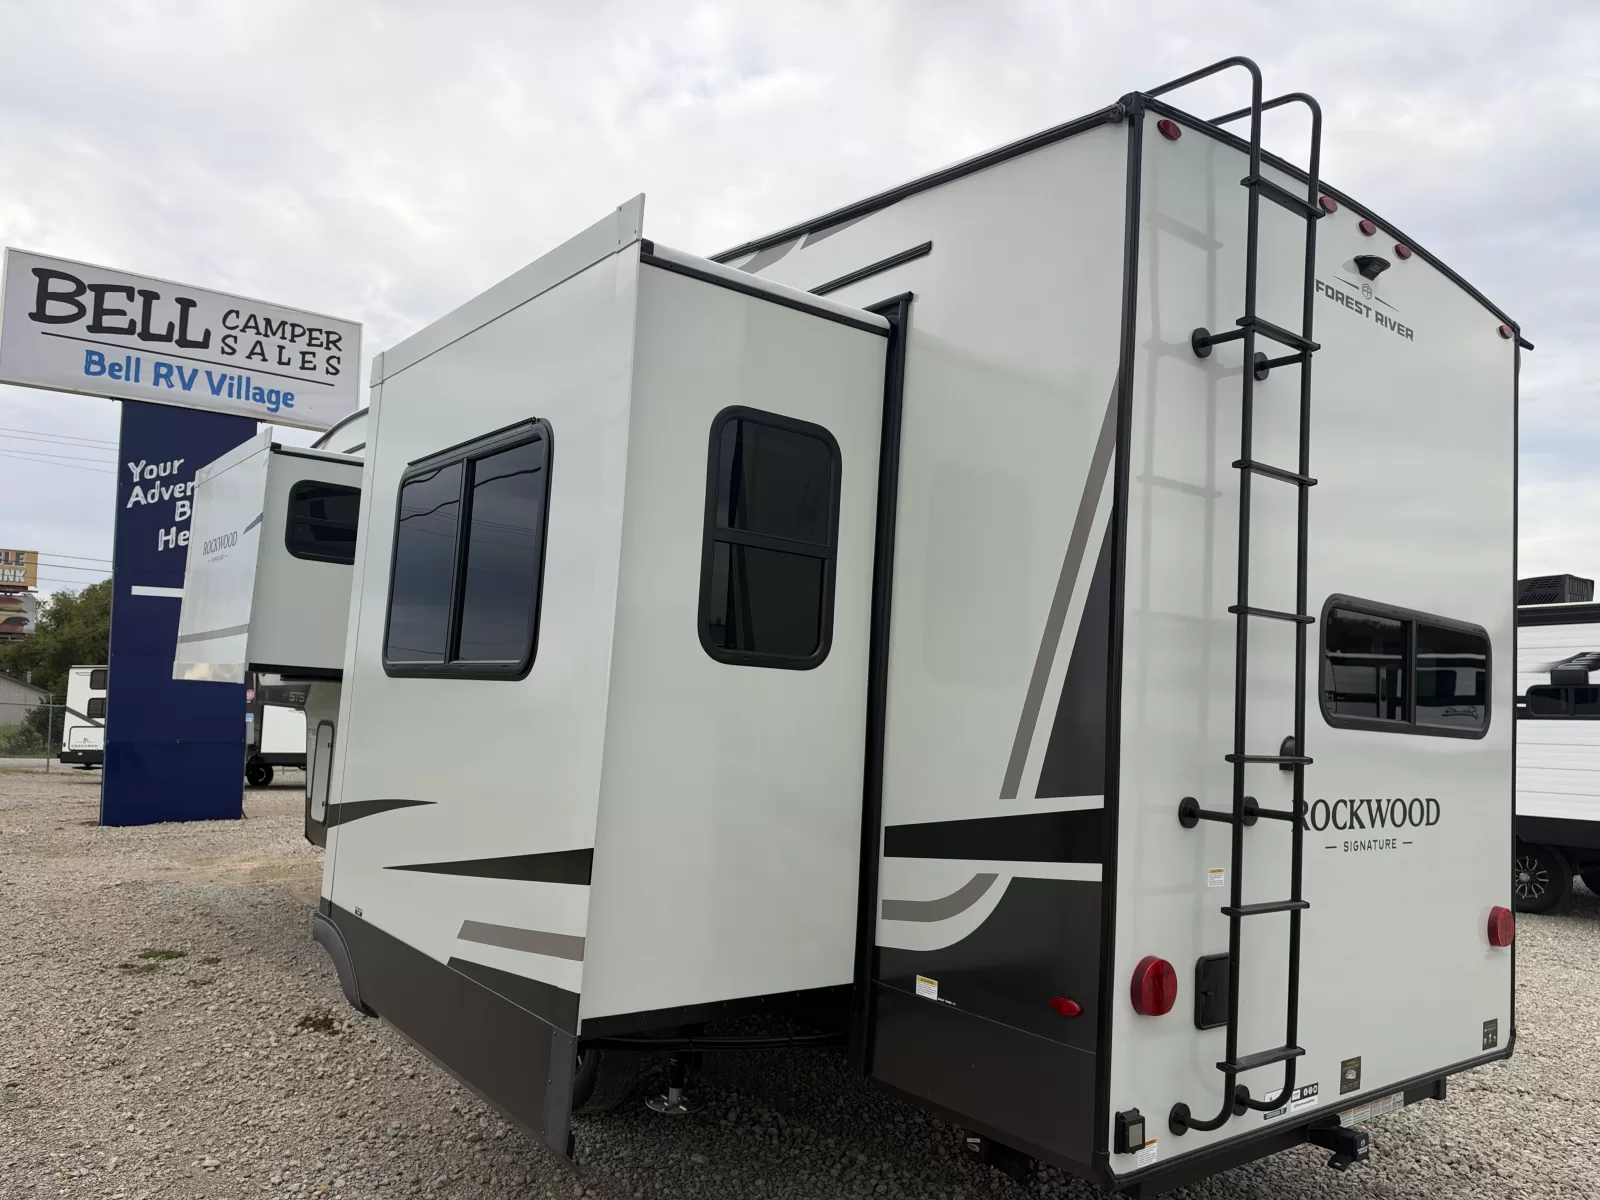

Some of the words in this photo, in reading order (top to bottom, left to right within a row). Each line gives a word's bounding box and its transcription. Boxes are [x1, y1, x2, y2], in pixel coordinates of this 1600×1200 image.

[28, 267, 211, 350] BELL
[1315, 279, 1372, 319] FOREST
[1374, 310, 1414, 341] RIVER
[220, 309, 343, 352] CAMPER
[220, 334, 341, 376] SALES
[84, 350, 140, 383] Bell
[153, 361, 198, 391] RV
[205, 370, 295, 412] Village
[128, 458, 184, 482] Your
[126, 480, 196, 508] Adver
[158, 526, 190, 551] He
[202, 531, 238, 556] ROCKWOOD
[1343, 838, 1397, 852] SIGNATURE
